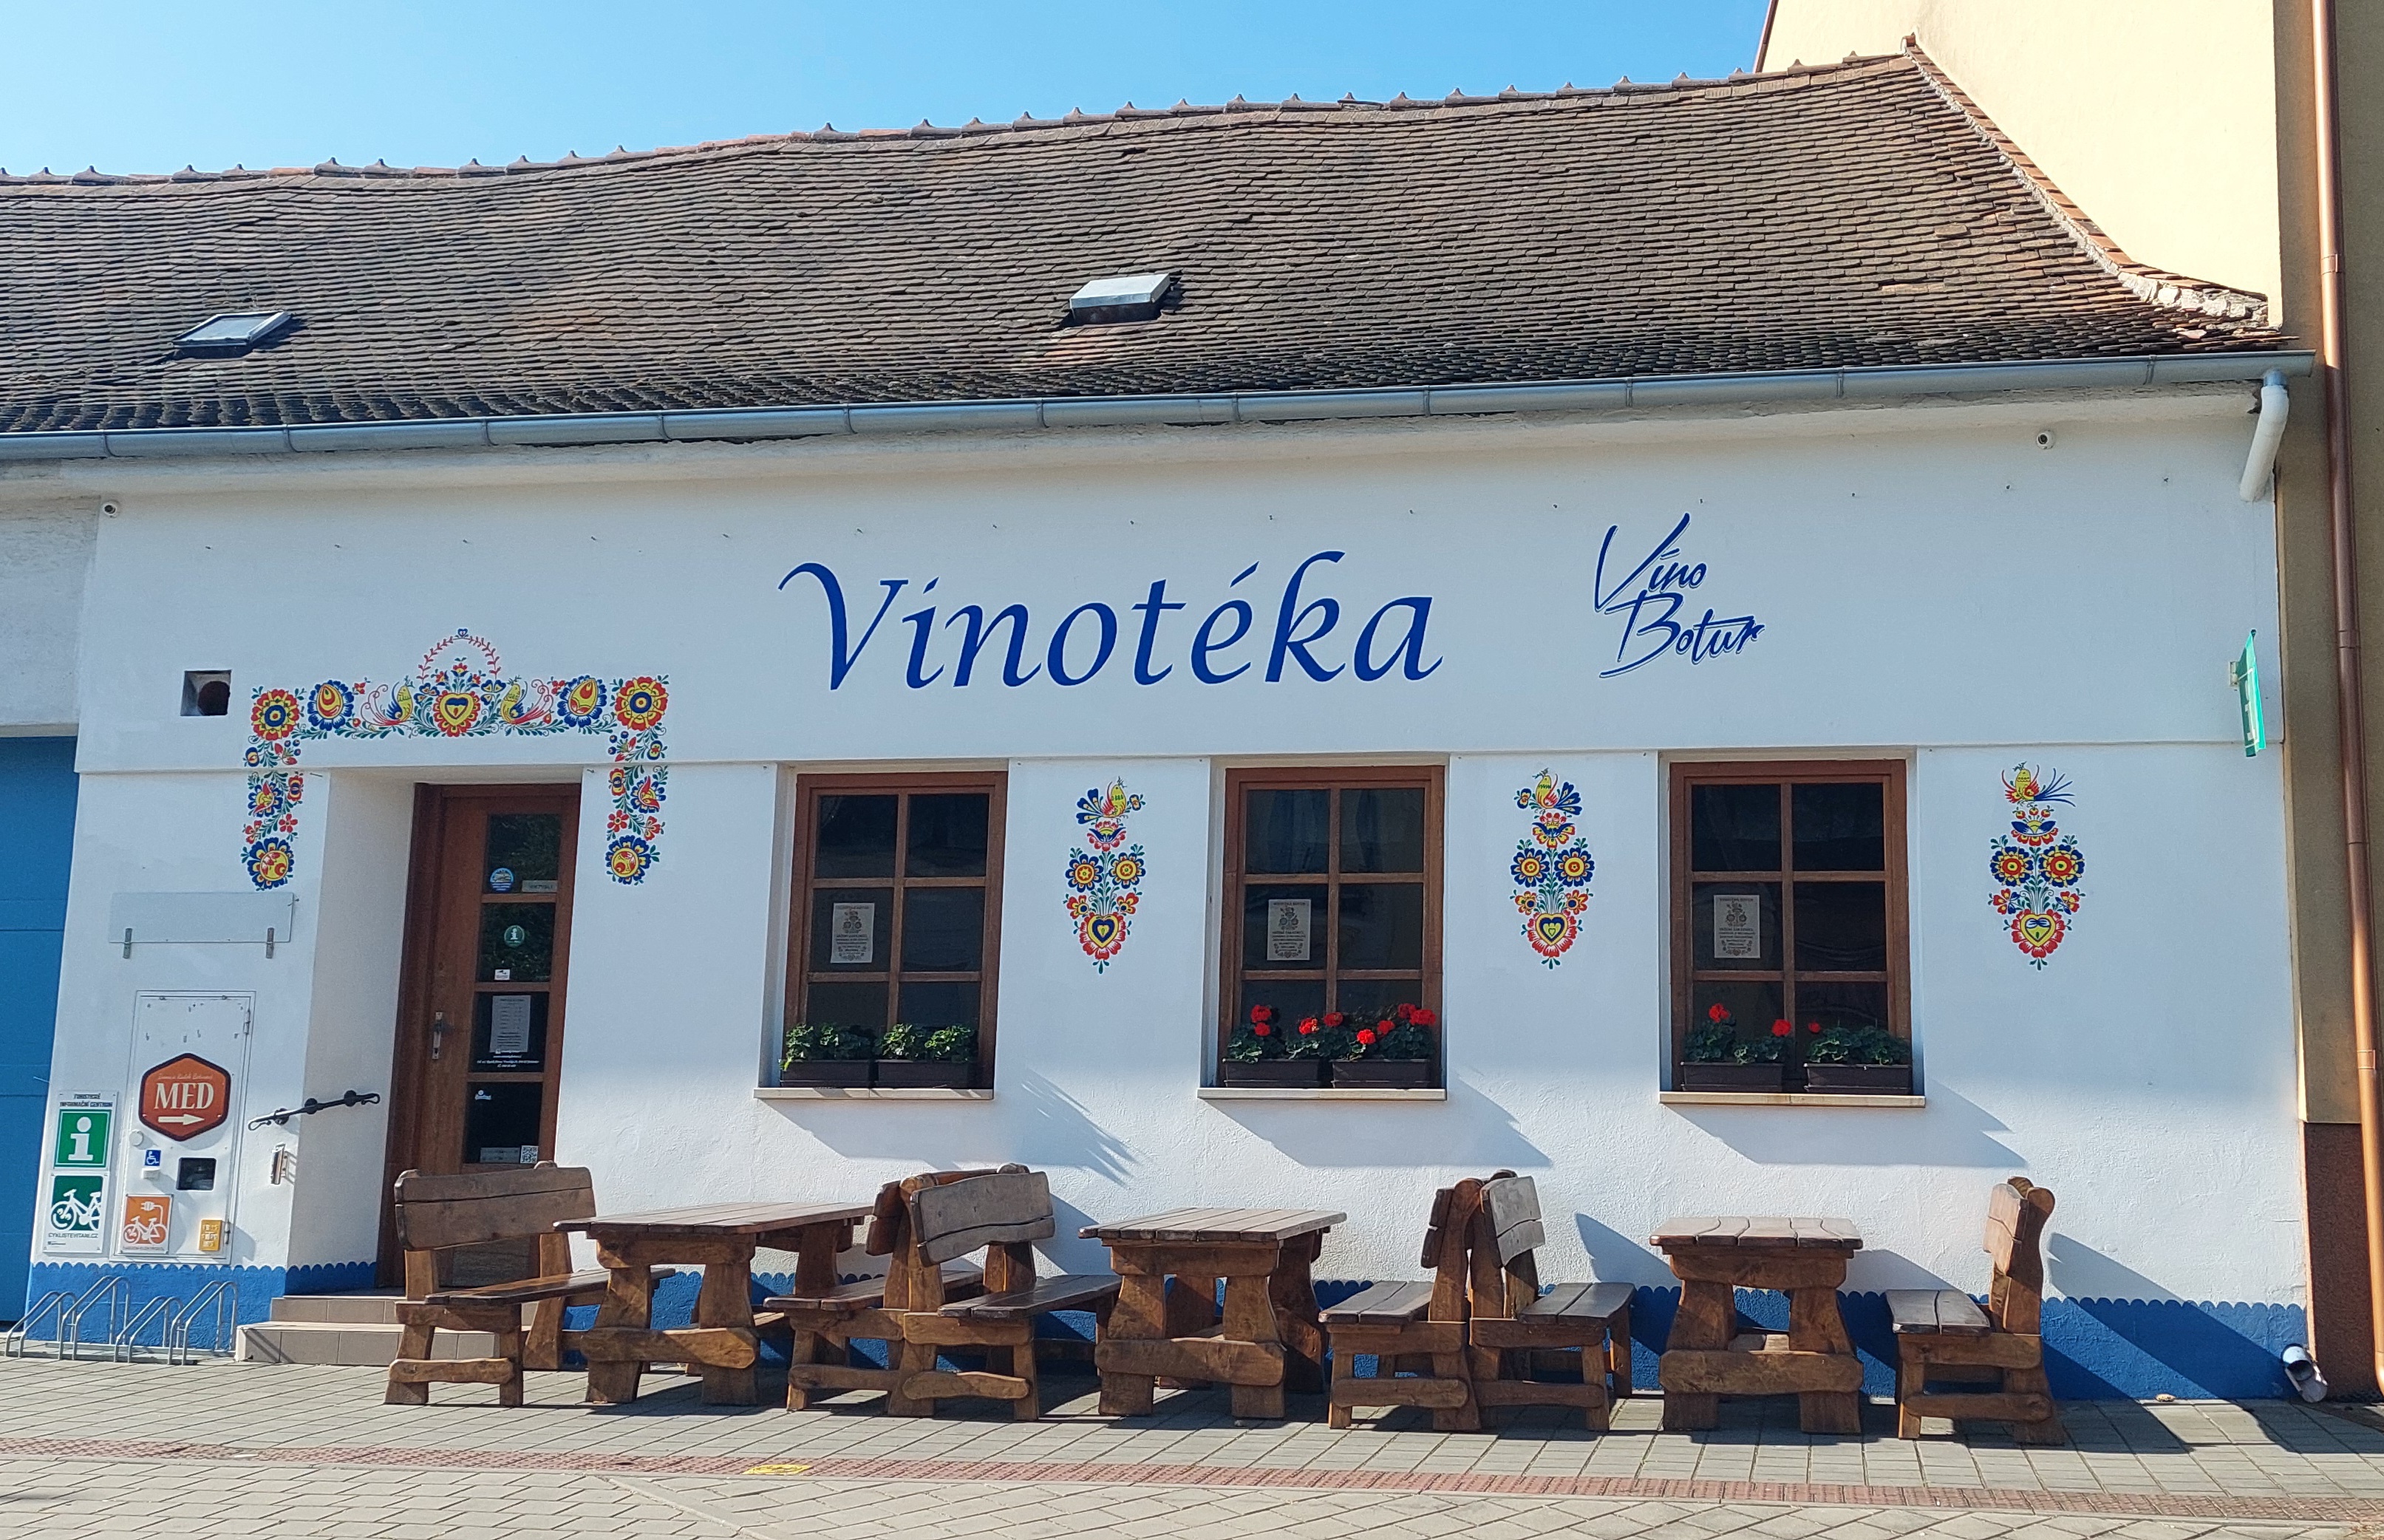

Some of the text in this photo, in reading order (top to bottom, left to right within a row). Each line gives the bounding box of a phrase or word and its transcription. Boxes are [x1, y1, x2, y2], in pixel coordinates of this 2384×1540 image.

[1595, 512, 1707, 610] Víno
[778, 551, 1443, 690] Vinotéka
[1599, 589, 1765, 678] Botur
[154, 1082, 215, 1110] MED
